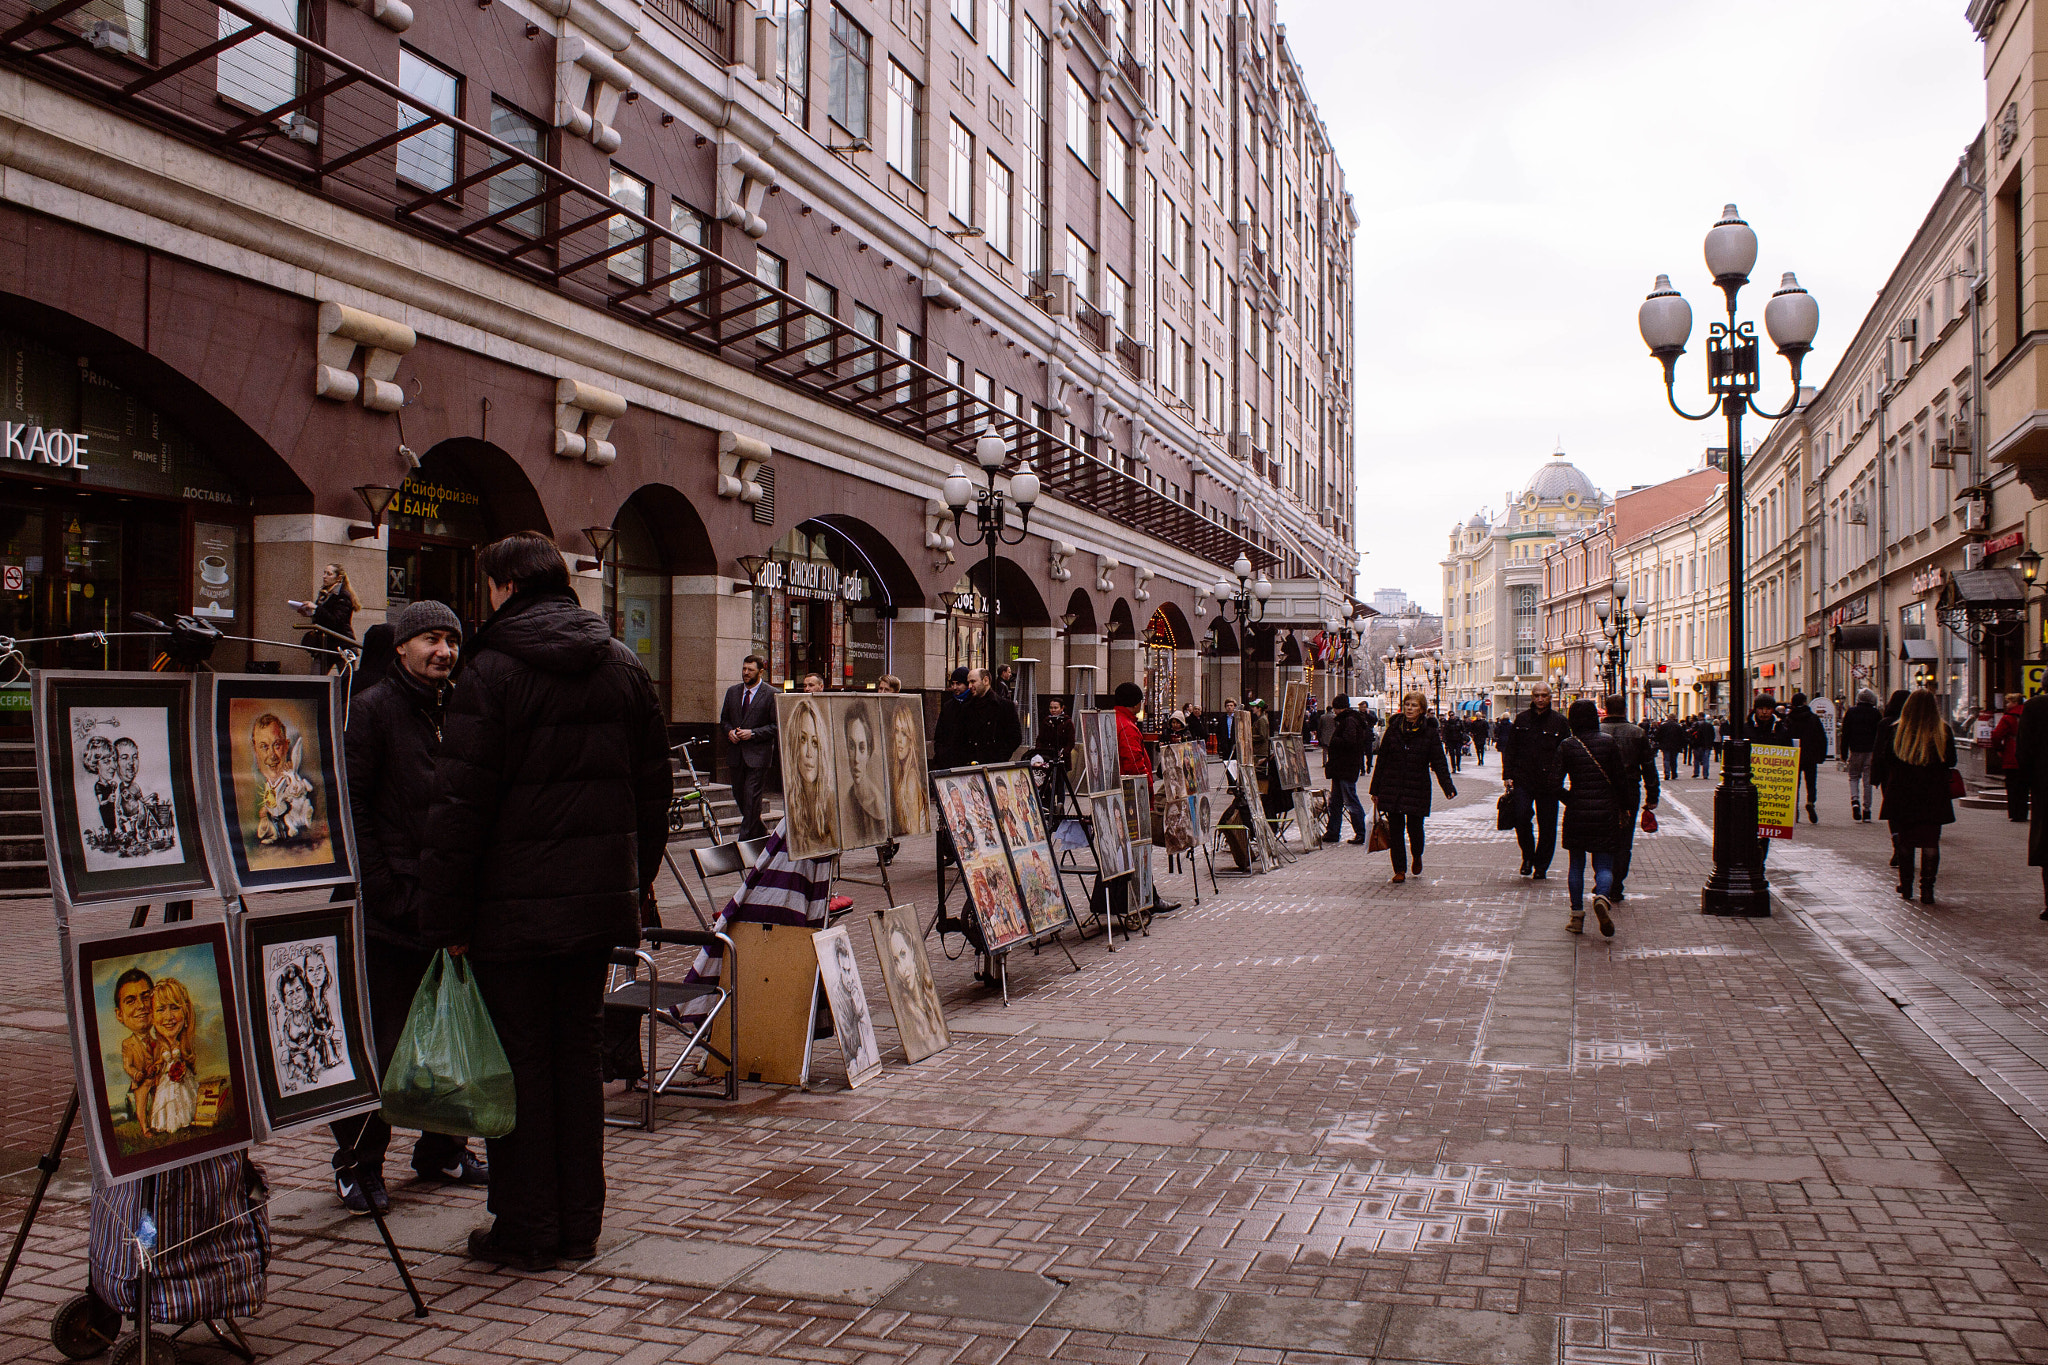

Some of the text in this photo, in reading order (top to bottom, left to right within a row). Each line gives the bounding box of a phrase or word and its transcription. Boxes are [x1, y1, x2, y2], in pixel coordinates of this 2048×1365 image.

[5, 420, 89, 470] КАФЕ
[132, 449, 158, 464] PRIME
[182, 486, 233, 504] ДОСТАВКА
[404, 477, 480, 505] Райффайзен
[403, 499, 440, 519] БАНК
[789, 560, 819, 589] CHICKEN
[844, 569, 862, 602] cafe
[1762, 757, 1796, 767] ОЦЕНКА
[1757, 767, 1794, 776] серебро
[1768, 784, 1793, 793] чугун
